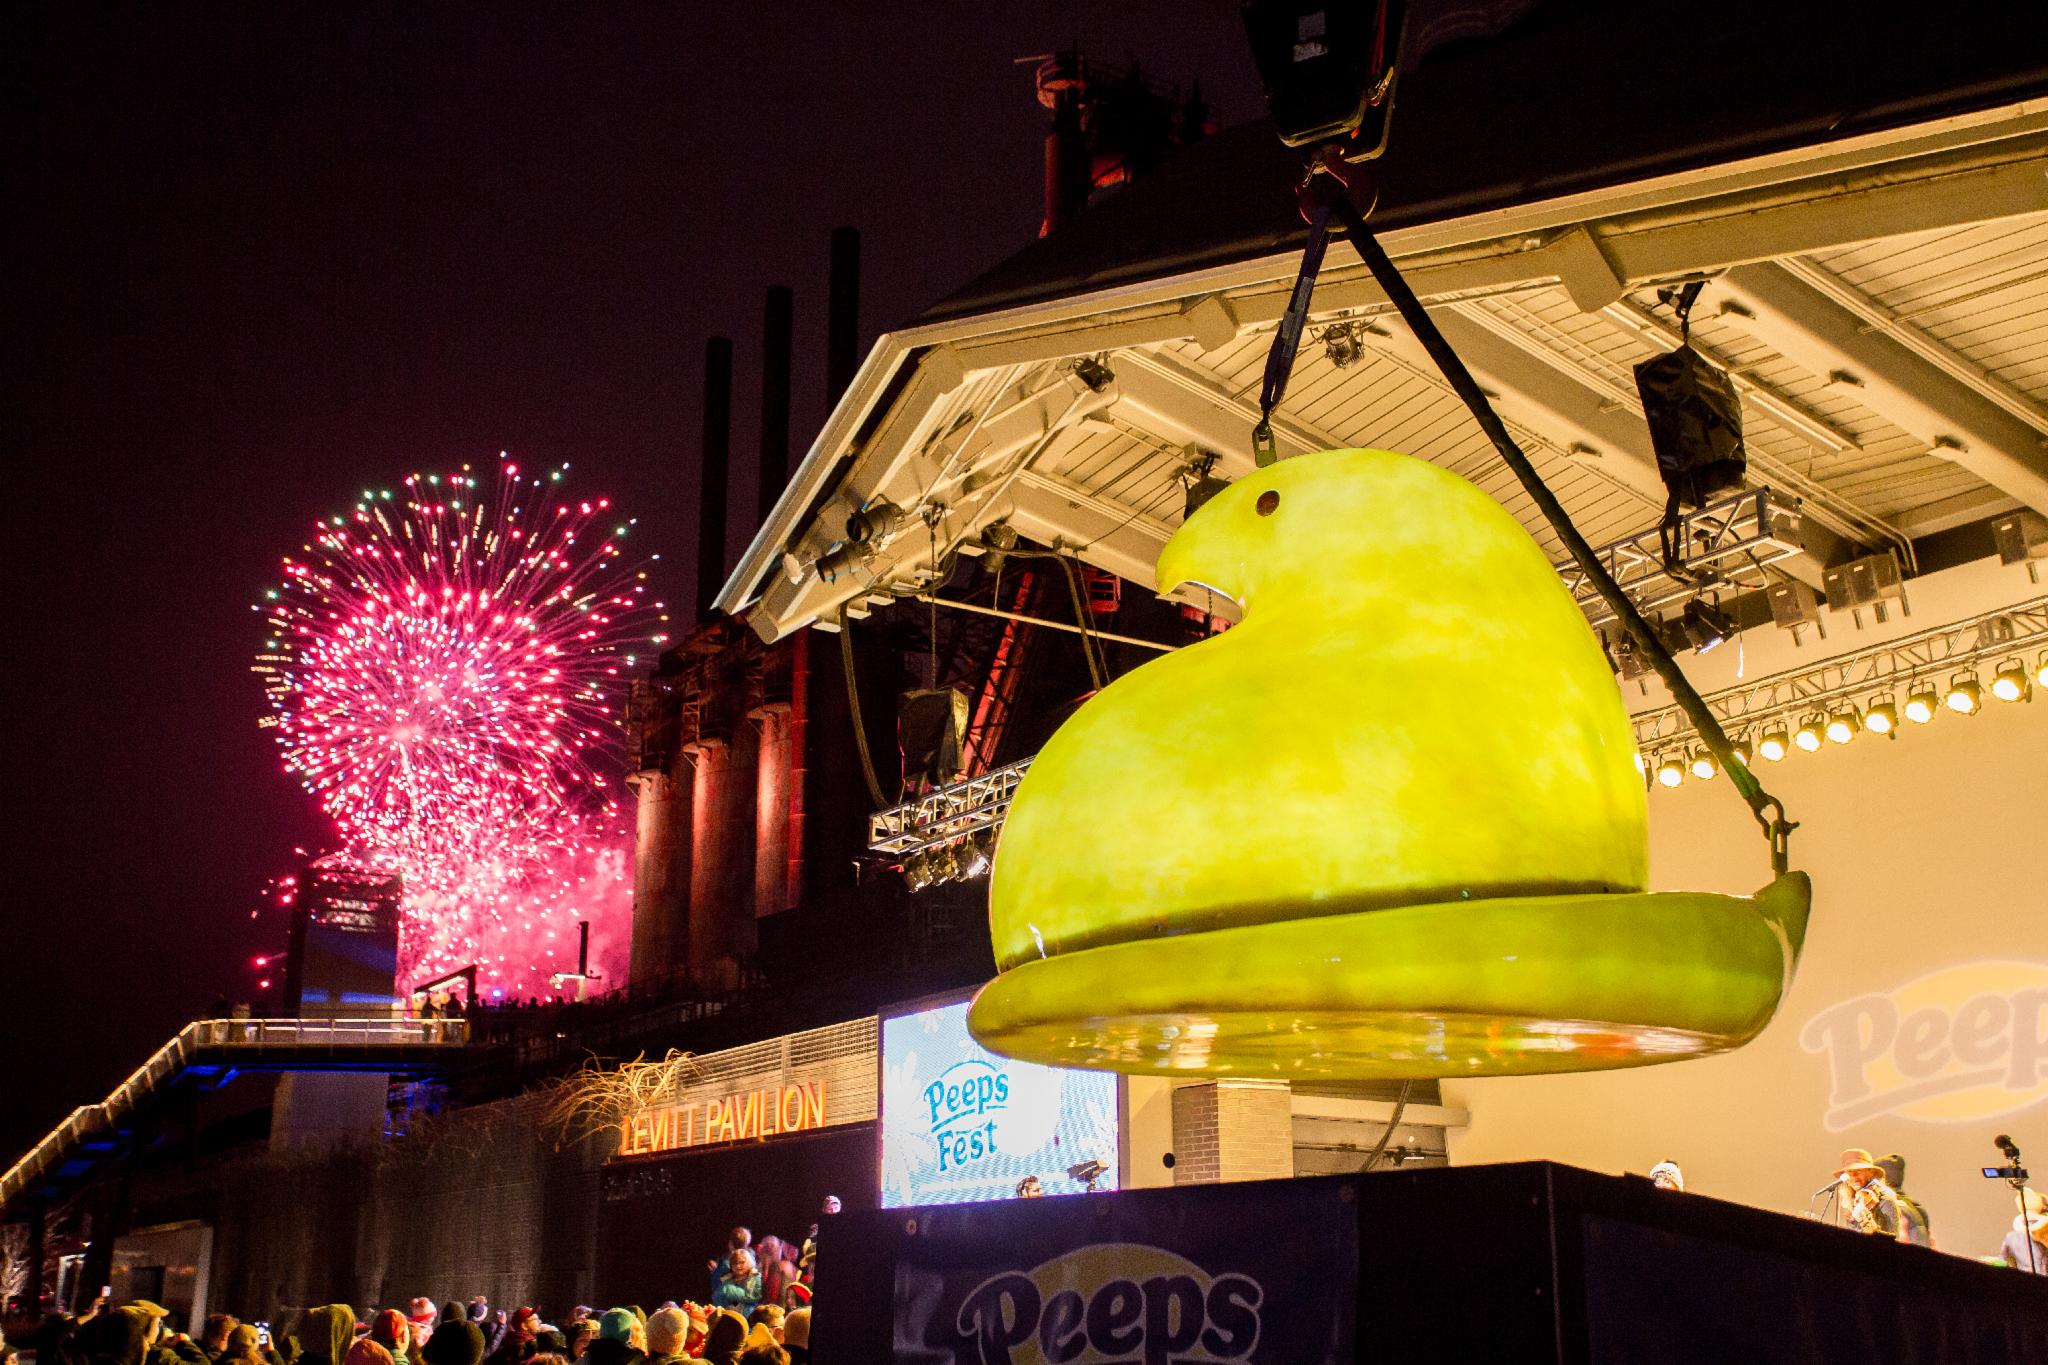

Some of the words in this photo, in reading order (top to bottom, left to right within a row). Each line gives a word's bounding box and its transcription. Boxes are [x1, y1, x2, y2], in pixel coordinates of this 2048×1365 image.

[619, 1103, 702, 1156] LEVITT
[705, 1079, 828, 1145] PAVILION
[924, 1073, 1009, 1124] Peeps
[937, 1119, 998, 1172] Fest
[956, 1270, 1264, 1365] Peeps
